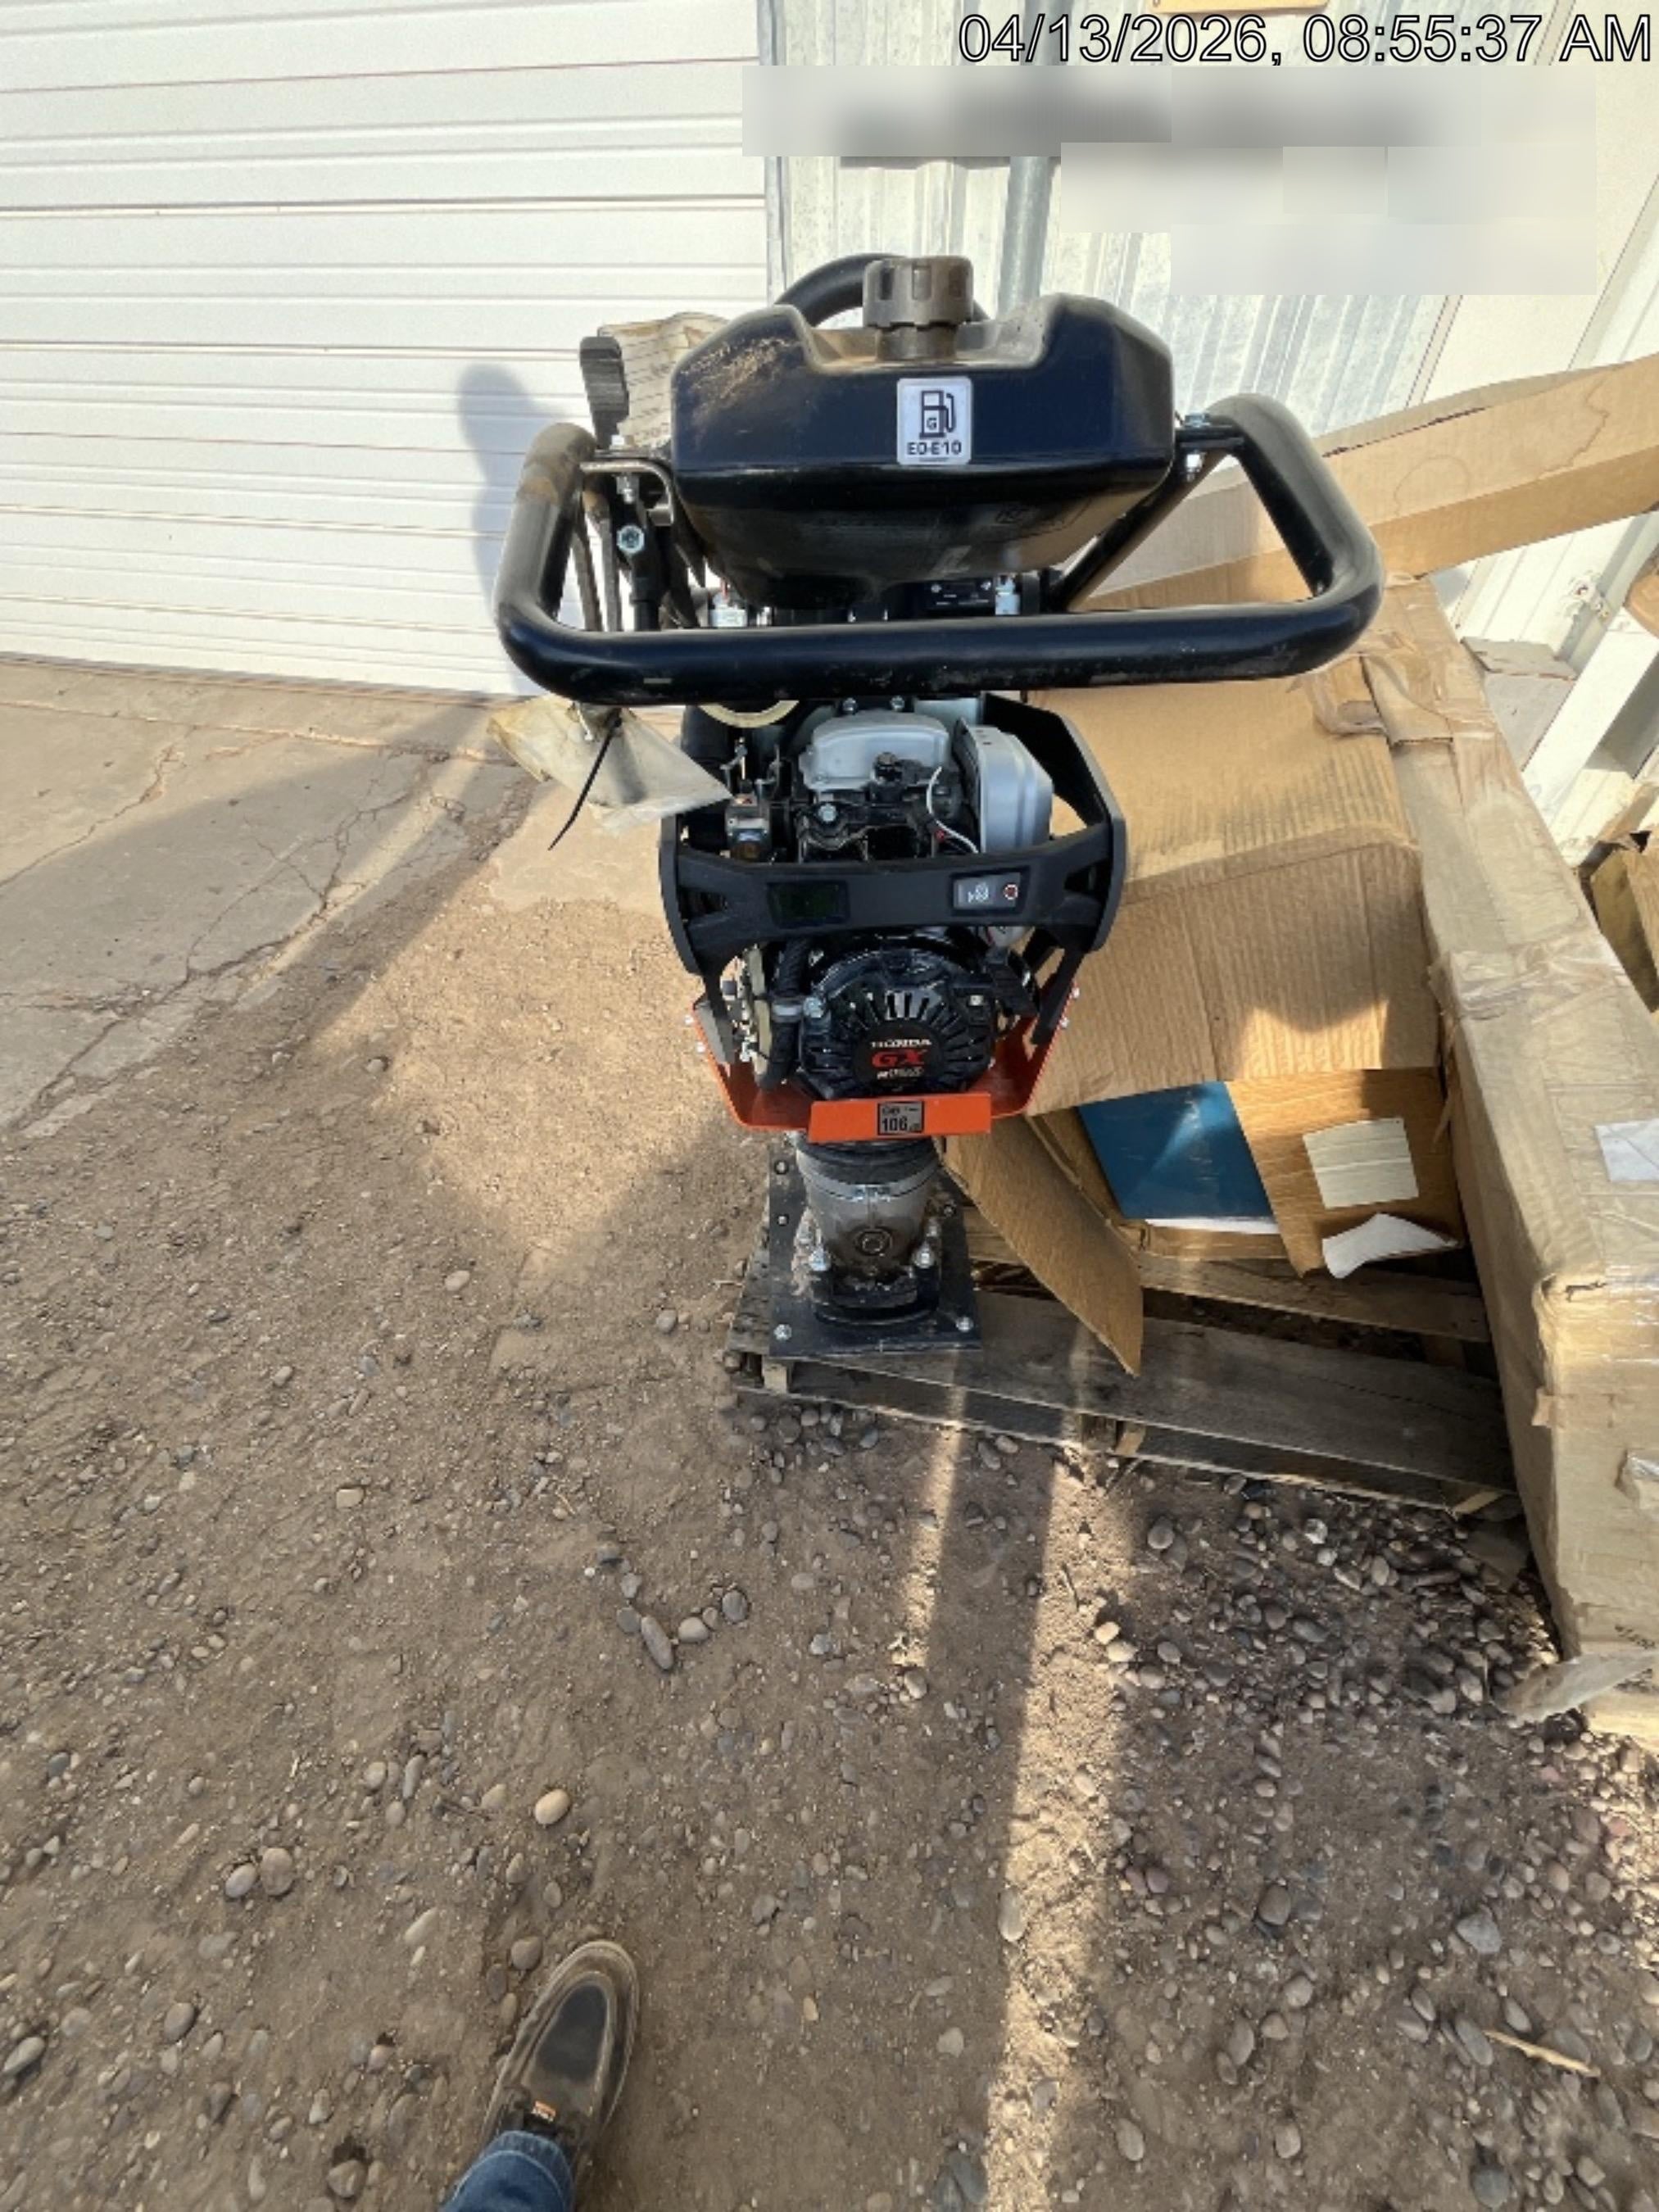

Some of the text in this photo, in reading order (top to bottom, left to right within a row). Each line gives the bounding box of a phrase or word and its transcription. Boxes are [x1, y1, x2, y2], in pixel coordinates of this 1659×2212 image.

[870, 1038, 932, 1049] HONDA
[872, 1049, 928, 1067] GX
[882, 1116, 908, 1132] 106
